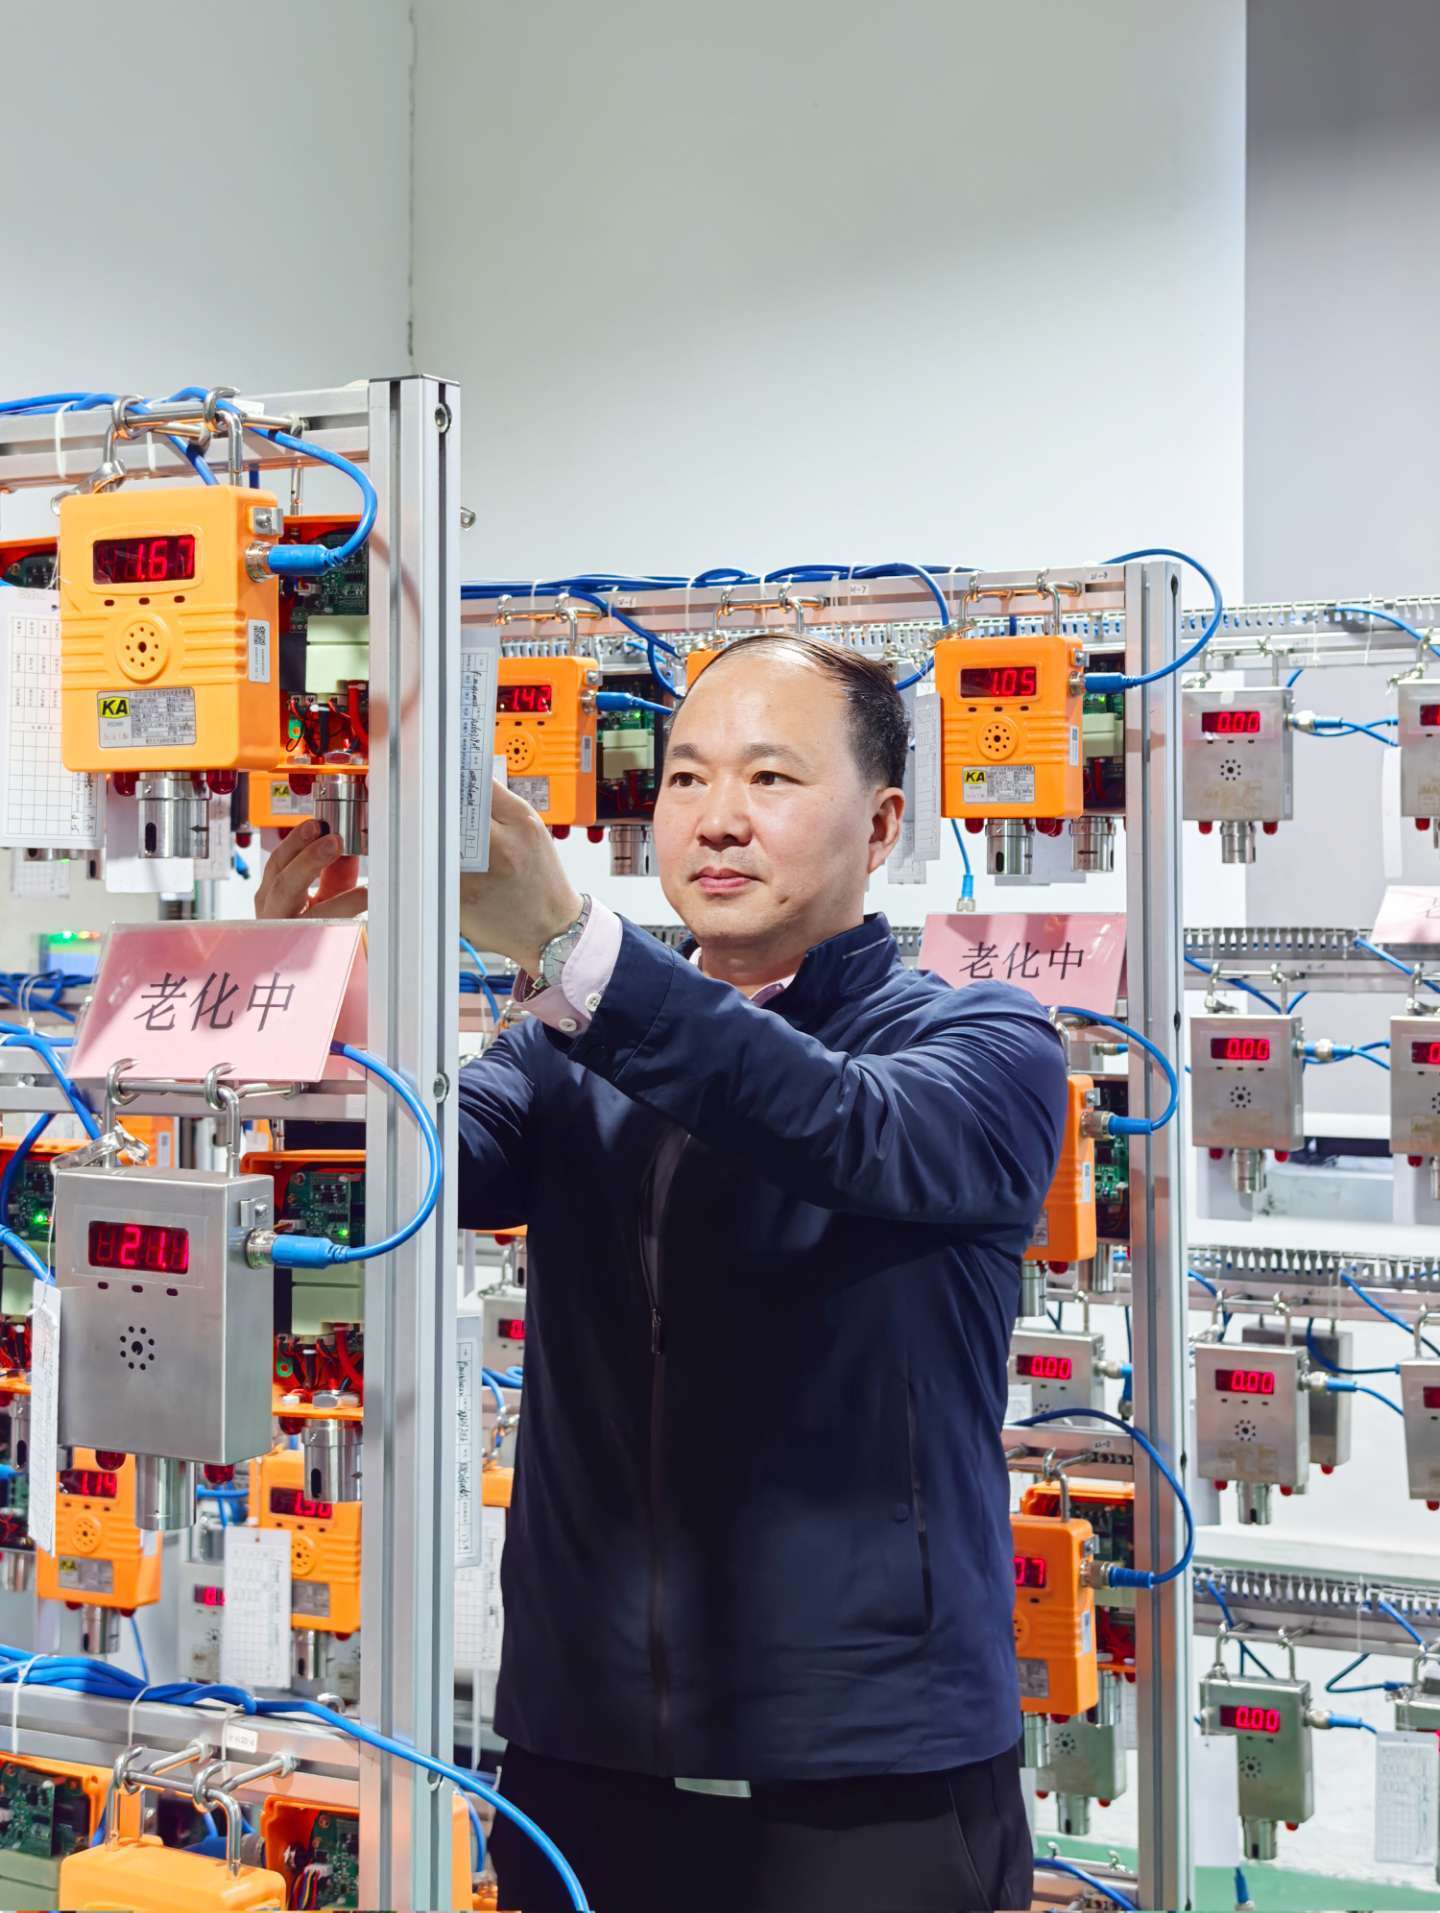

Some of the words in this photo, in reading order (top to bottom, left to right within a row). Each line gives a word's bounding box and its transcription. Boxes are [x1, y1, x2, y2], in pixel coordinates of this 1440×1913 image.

[992, 668, 1035, 696] 1.05
[102, 700, 128, 716] KA
[966, 771, 985, 783] KA
[960, 941, 1084, 980] 老化中
[134, 972, 296, 1032] 老化中
